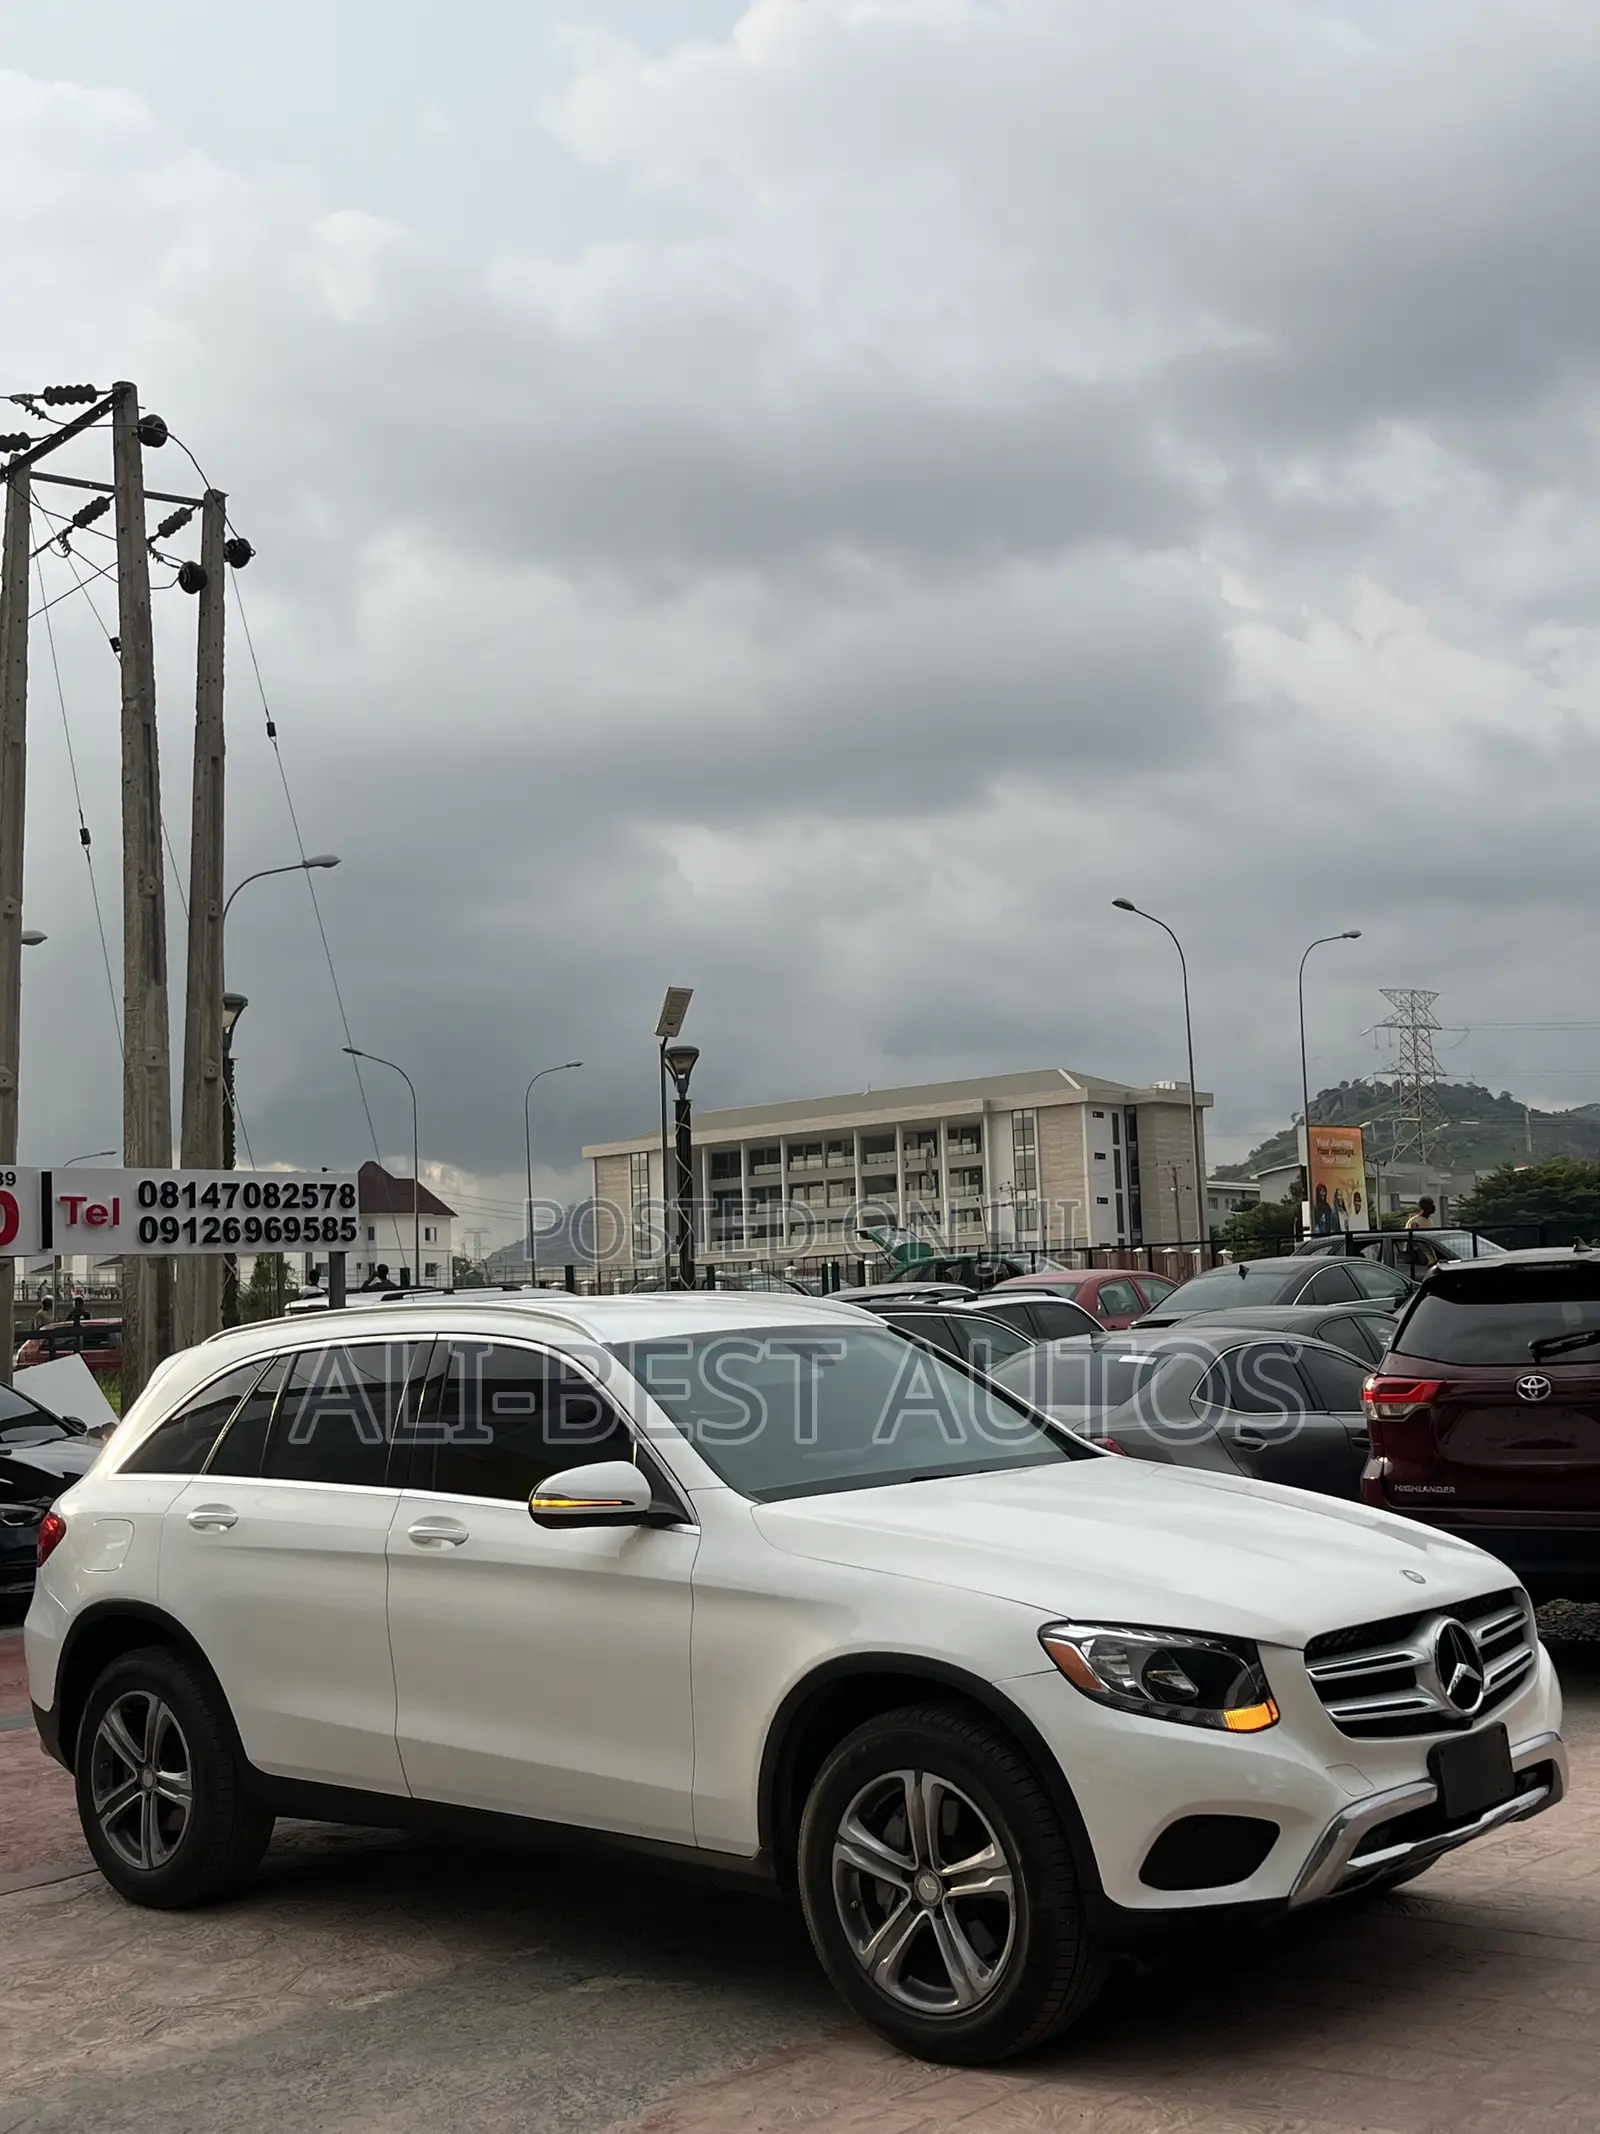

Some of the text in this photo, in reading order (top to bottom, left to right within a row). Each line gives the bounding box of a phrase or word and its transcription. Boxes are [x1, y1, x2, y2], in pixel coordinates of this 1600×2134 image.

[137, 1180, 356, 1210] 08147082578
[60, 1196, 120, 1226] Tel
[138, 1215, 357, 1245] 09126969585
[1394, 1484, 1456, 1493] HIGHLANDER
